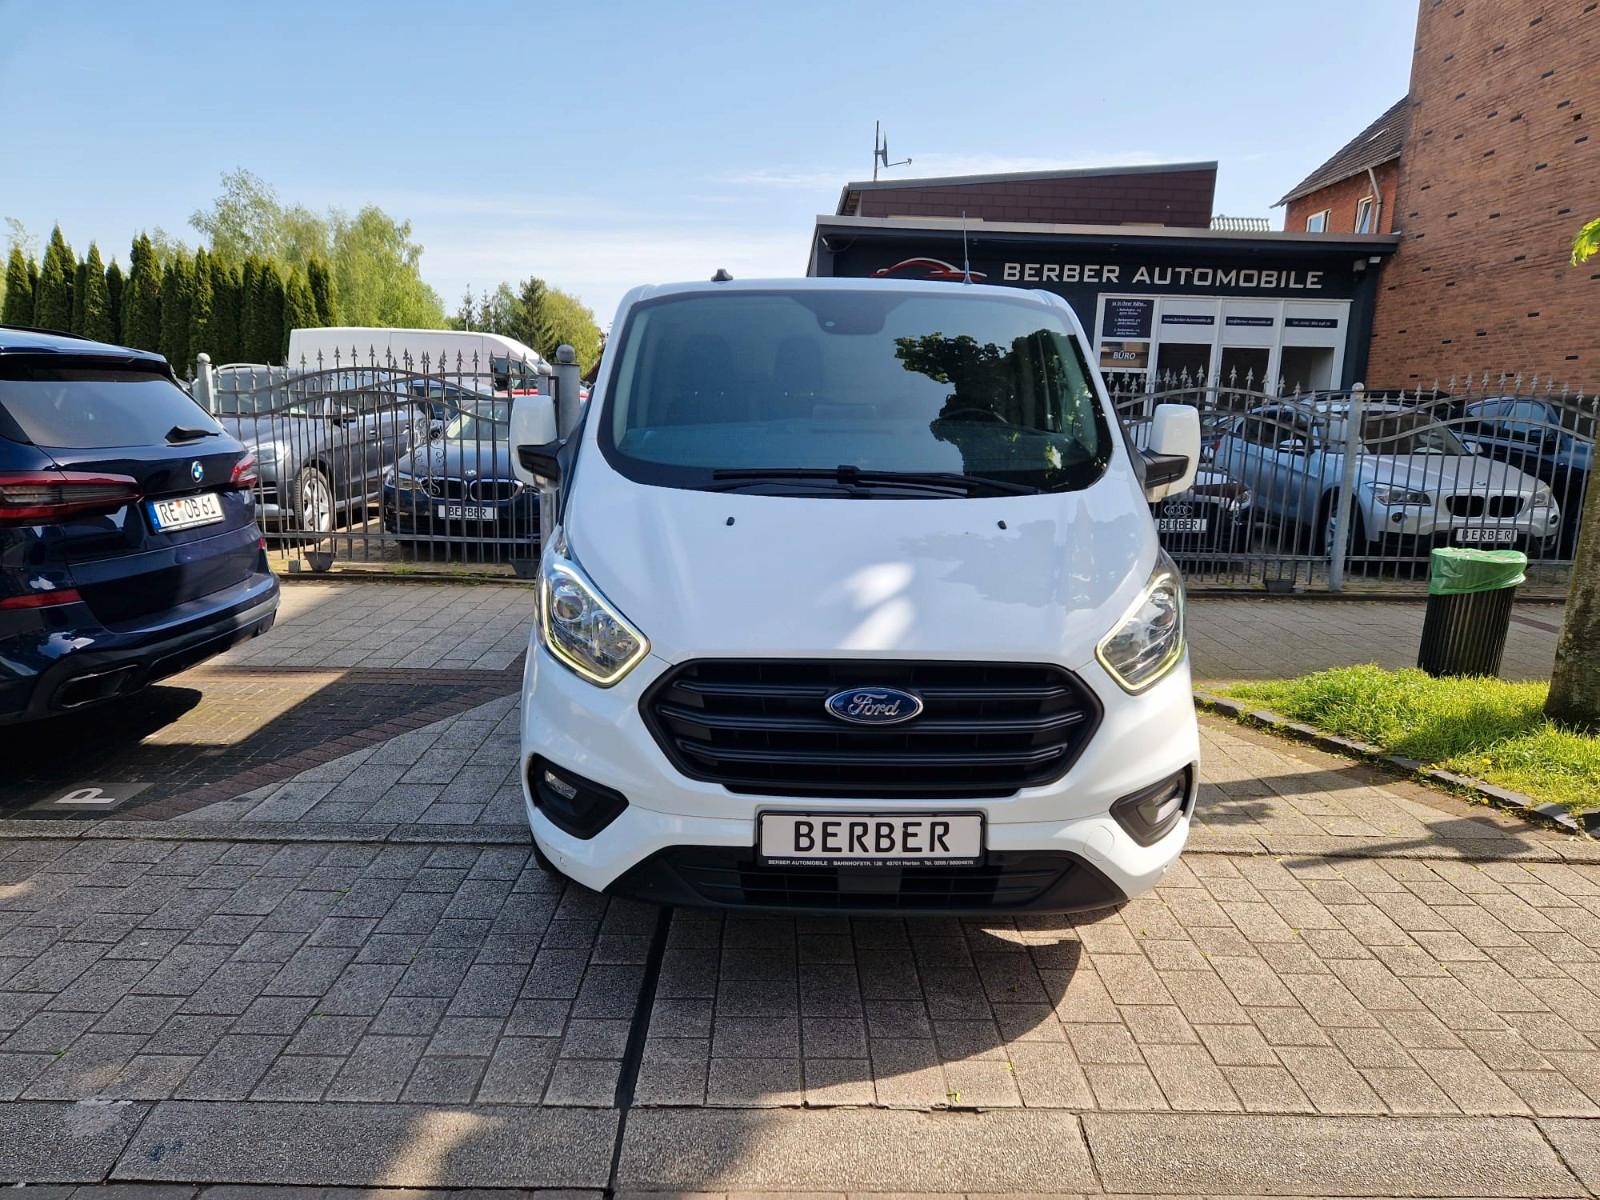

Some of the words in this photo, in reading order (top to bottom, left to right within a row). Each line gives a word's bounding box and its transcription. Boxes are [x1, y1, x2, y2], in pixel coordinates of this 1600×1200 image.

[1003, 262, 1120, 284] BERBER
[1131, 267, 1324, 289] AUTOMOBILE
[1112, 350, 1136, 360] BÜRO
[159, 502, 180, 524] RE
[184, 499, 201, 519] OB
[202, 496, 217, 516] 61
[847, 693, 901, 716] Ford
[794, 820, 951, 853] BERBER
